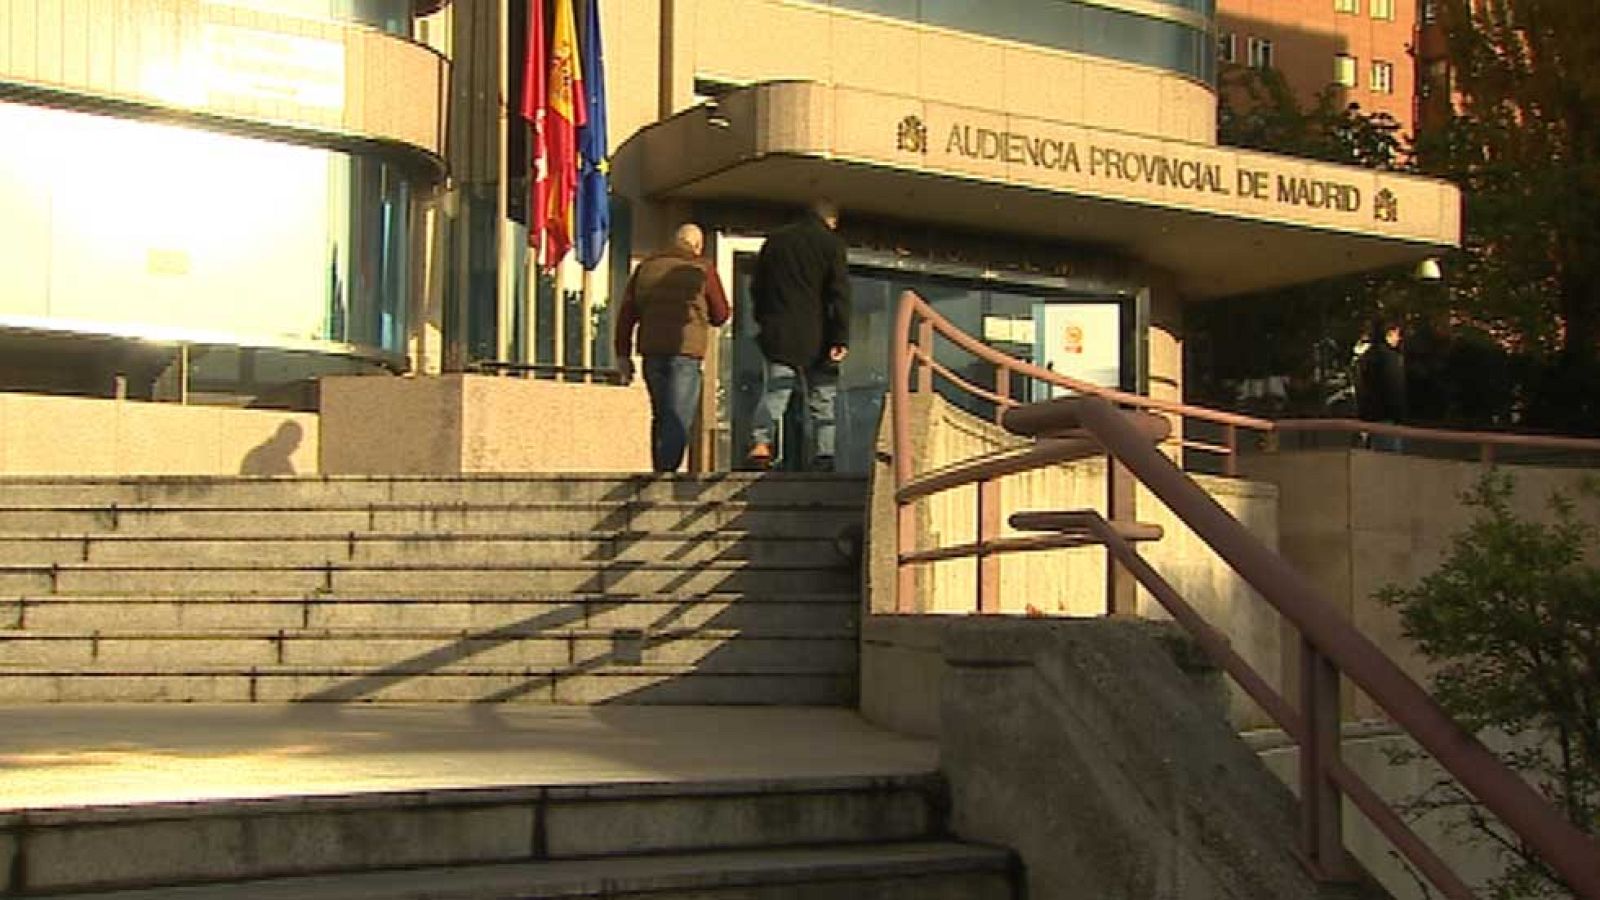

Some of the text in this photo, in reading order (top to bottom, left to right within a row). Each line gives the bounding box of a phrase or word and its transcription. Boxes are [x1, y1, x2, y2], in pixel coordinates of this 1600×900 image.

[946, 123, 1361, 212] AUDIENCIA PROVINCIAL DE MADRID
